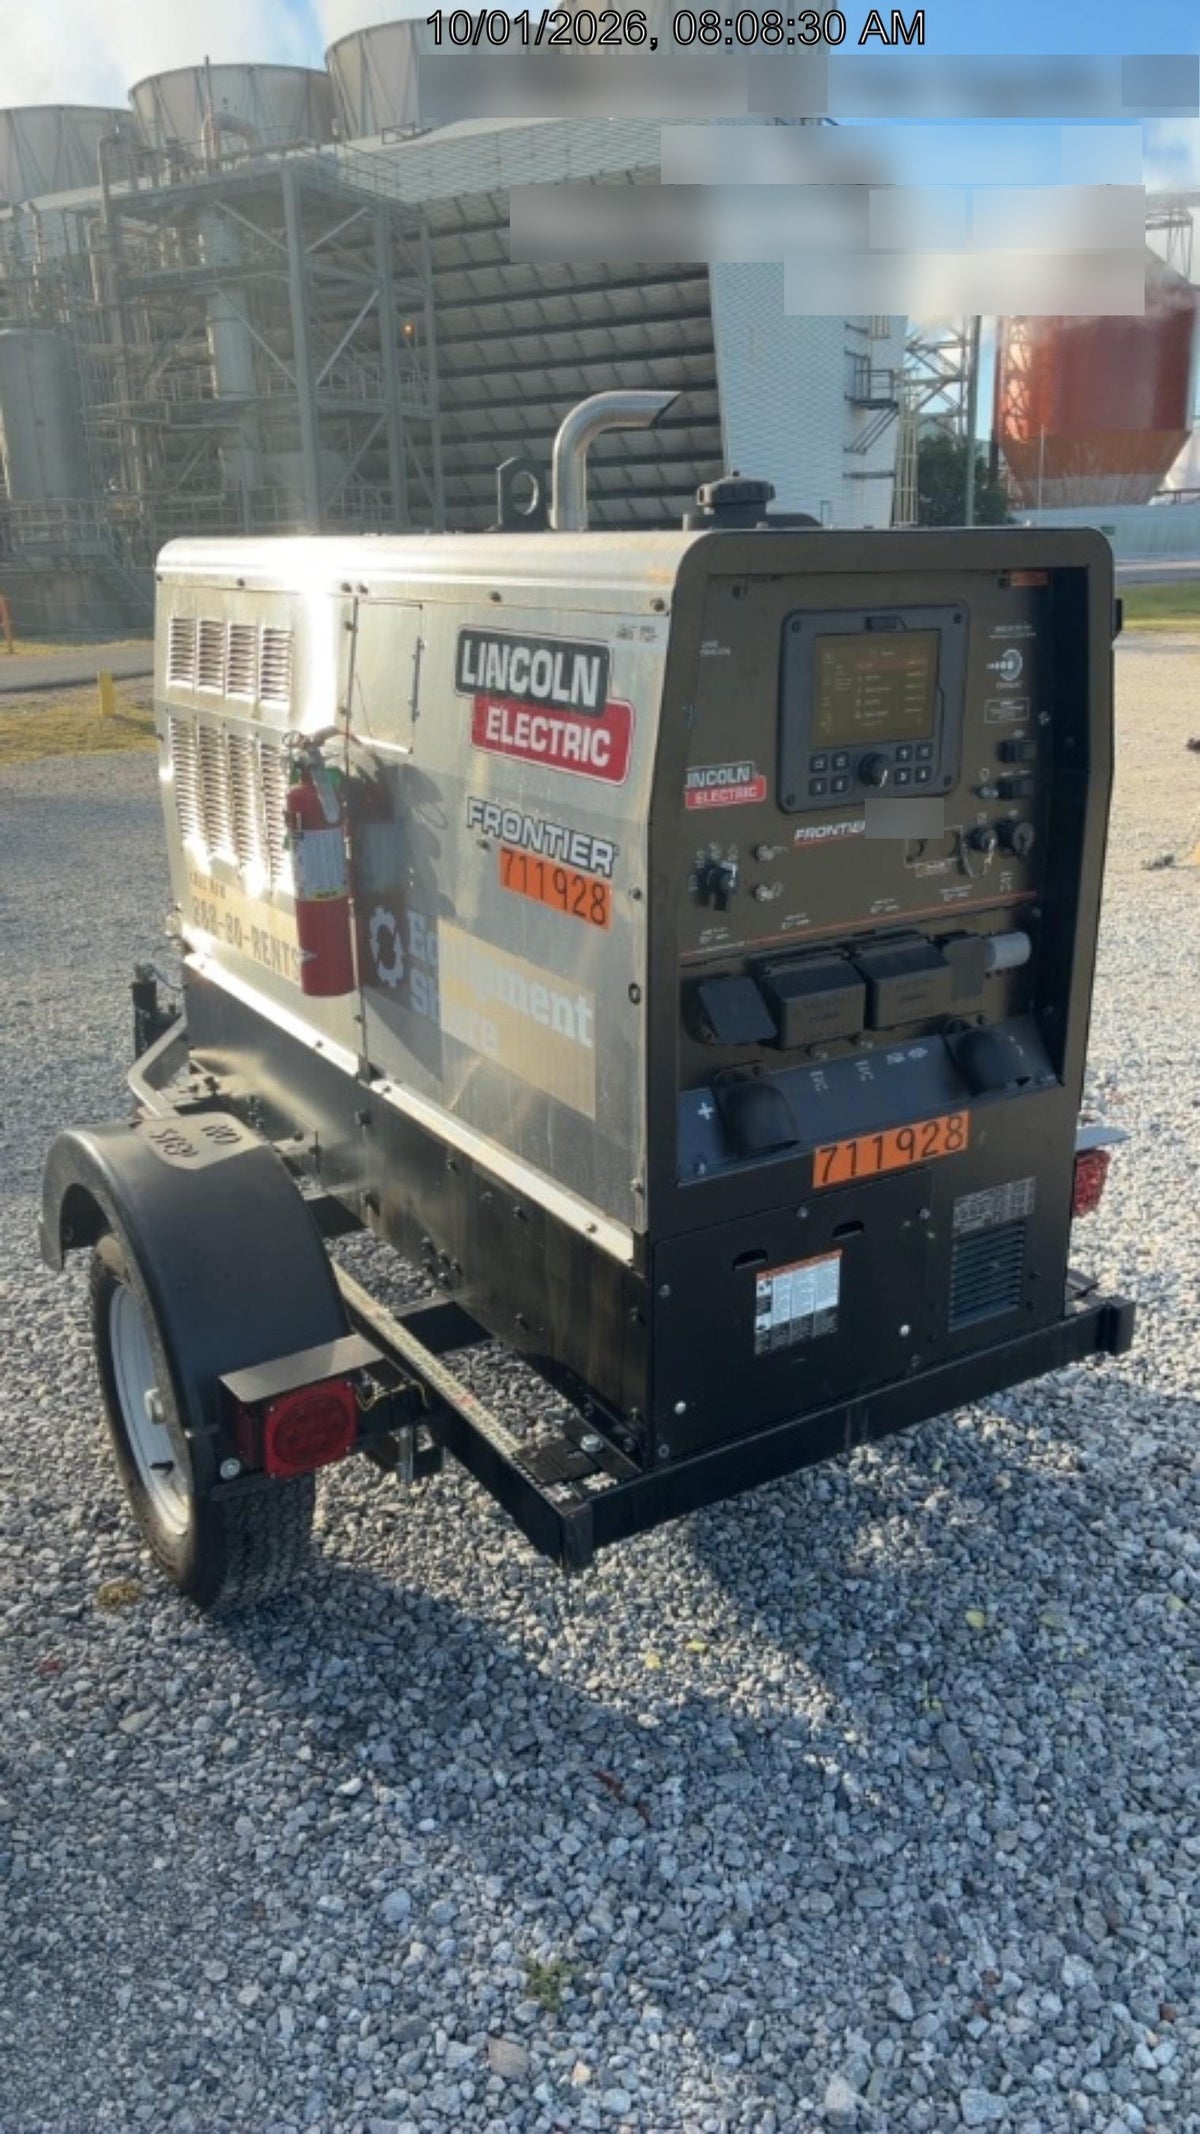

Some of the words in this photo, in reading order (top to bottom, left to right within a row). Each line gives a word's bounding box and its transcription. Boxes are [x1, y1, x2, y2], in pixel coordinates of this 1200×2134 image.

[461, 640, 600, 707] LINCOLN
[485, 706, 611, 767] ELECTRIC
[686, 766, 750, 787] INCOLN
[695, 785, 757, 806] ELECTRIC
[466, 797, 617, 878] FRONTIER
[501, 847, 607, 926] 711928
[820, 1114, 965, 1184] 711928
